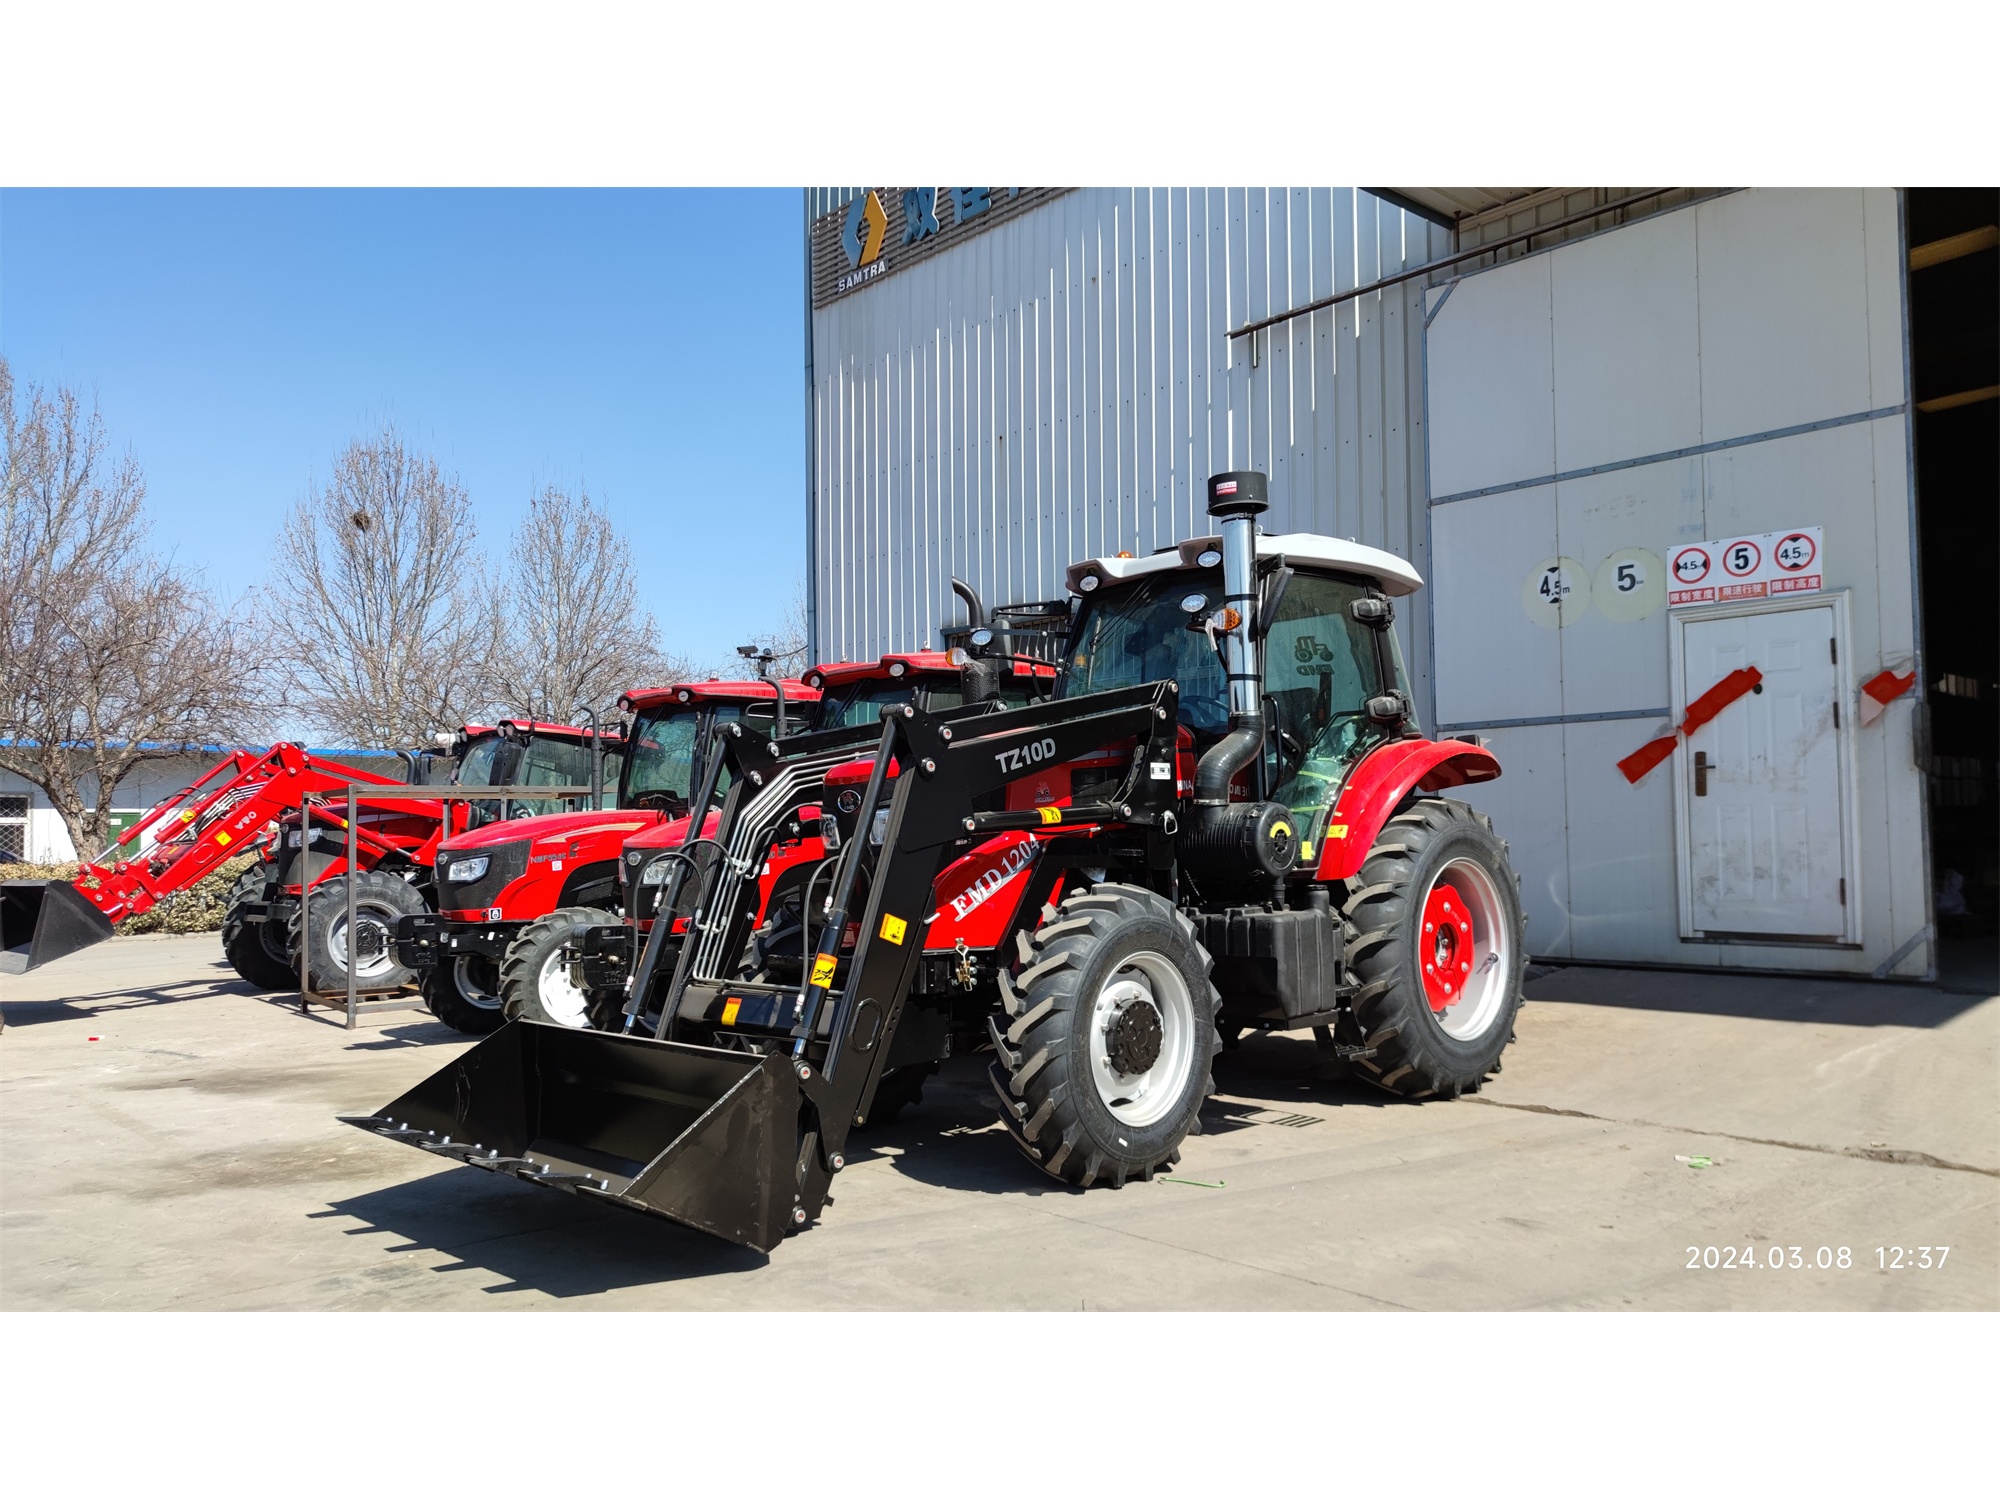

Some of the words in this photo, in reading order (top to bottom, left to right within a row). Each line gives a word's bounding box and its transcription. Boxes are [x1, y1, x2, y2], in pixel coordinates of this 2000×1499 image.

[838, 260, 886, 292] SAMTRA
[1734, 548, 1749, 570] 5
[1780, 546, 1810, 560] 4.5m
[1540, 575, 1570, 597] 4.5m
[1771, 577, 1819, 592] 限制高度
[1670, 589, 1714, 603] 限制宽度
[995, 738, 1056, 774] TZ10D
[1176, 779, 1193, 792] HINA
[234, 811, 257, 830] YTO
[1001, 832, 1040, 876] 1204
